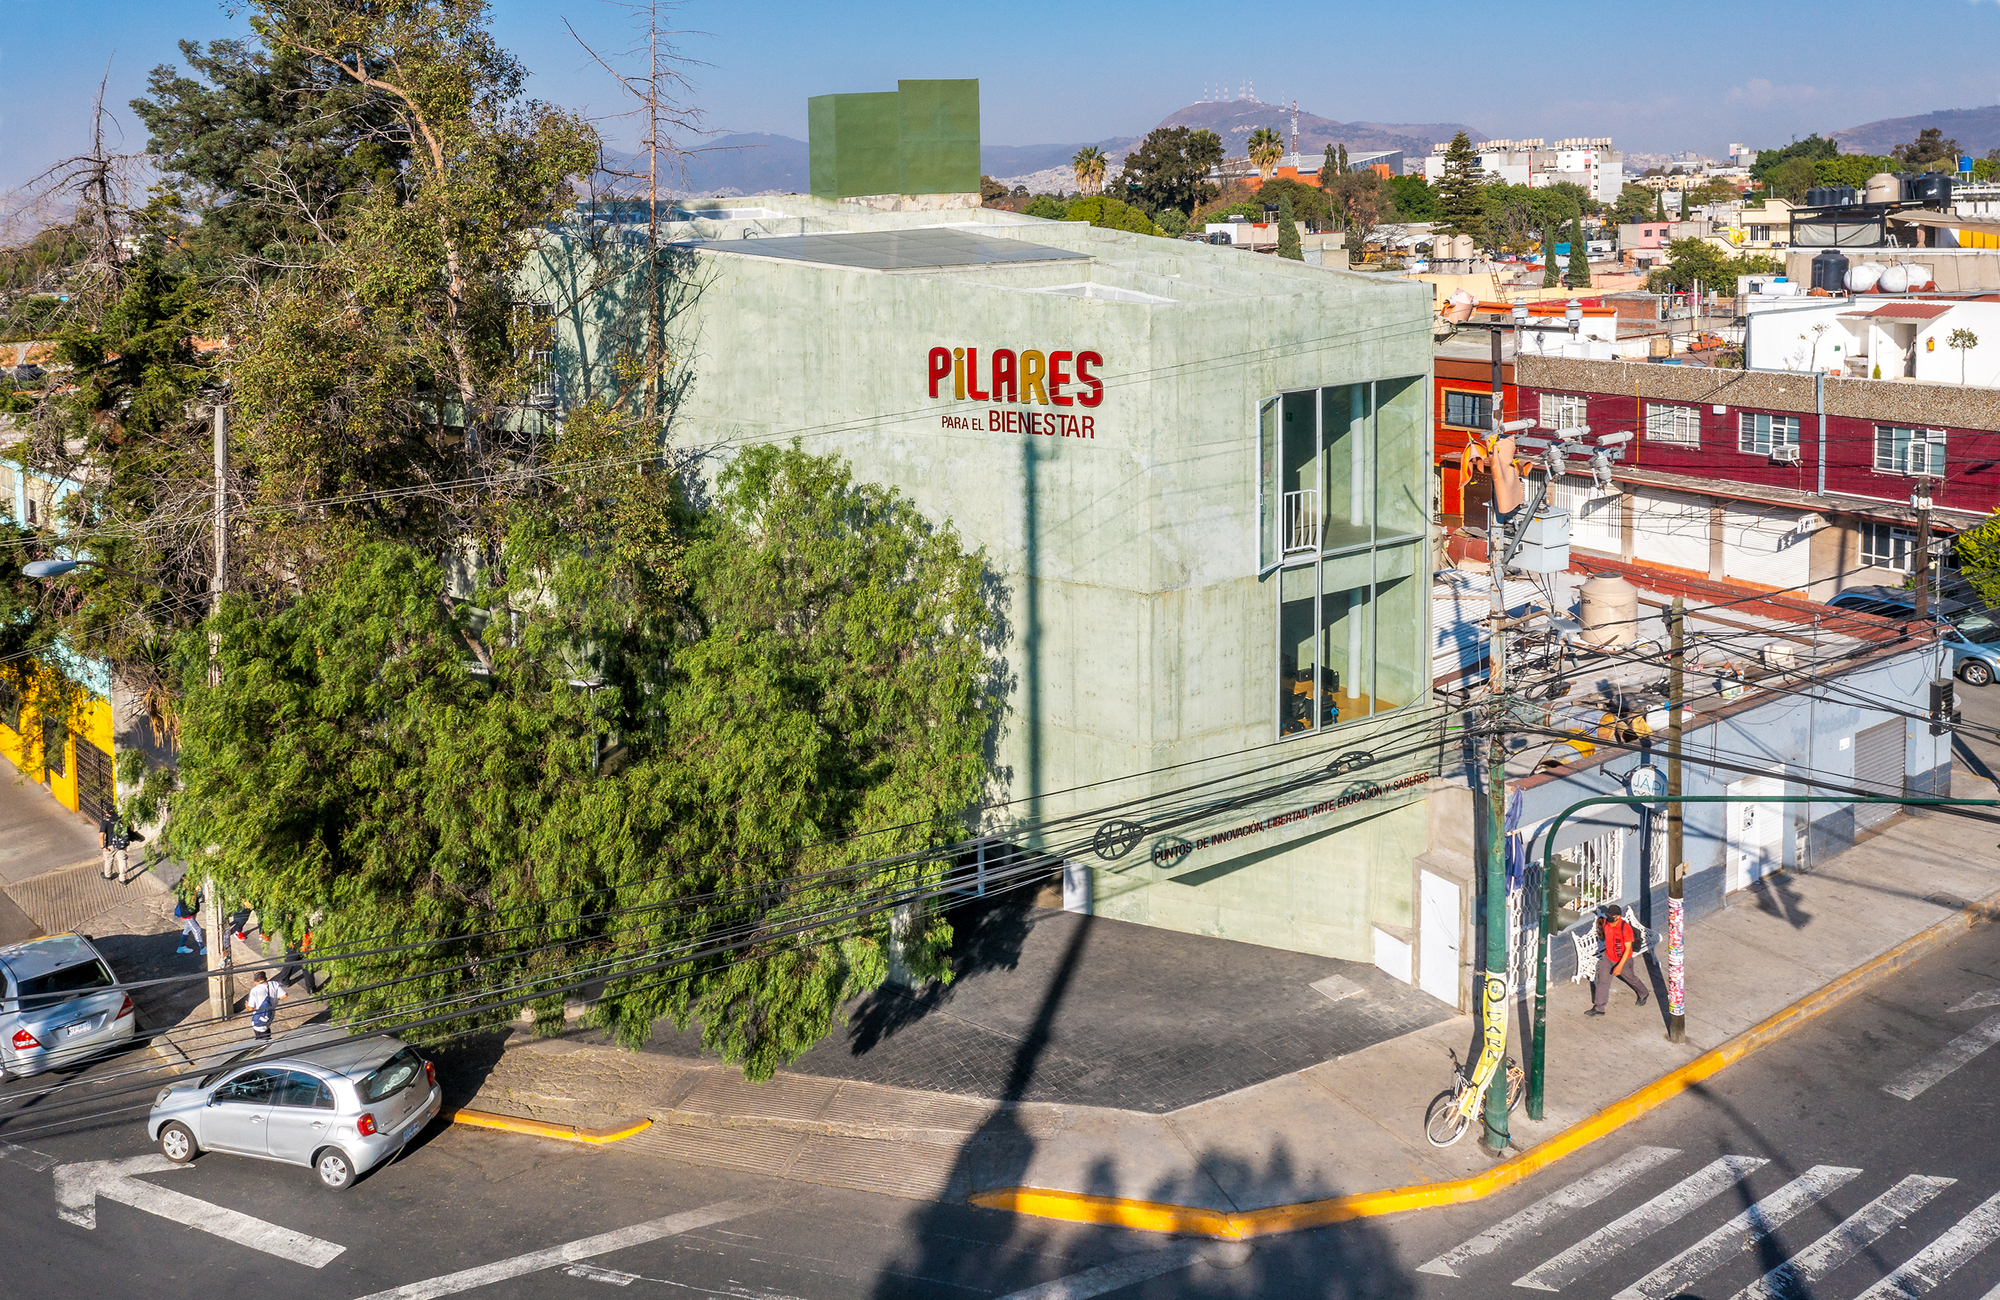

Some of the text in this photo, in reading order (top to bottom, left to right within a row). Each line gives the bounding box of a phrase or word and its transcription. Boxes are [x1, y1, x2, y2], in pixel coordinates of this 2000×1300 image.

[941, 410, 1095, 439] PARA EL BIENESTAR
[1154, 771, 1430, 864] PUNTOS DE INNOVACIÓN, LIBERTAD, ARTE, EDUCACIÓN Y SABERES
